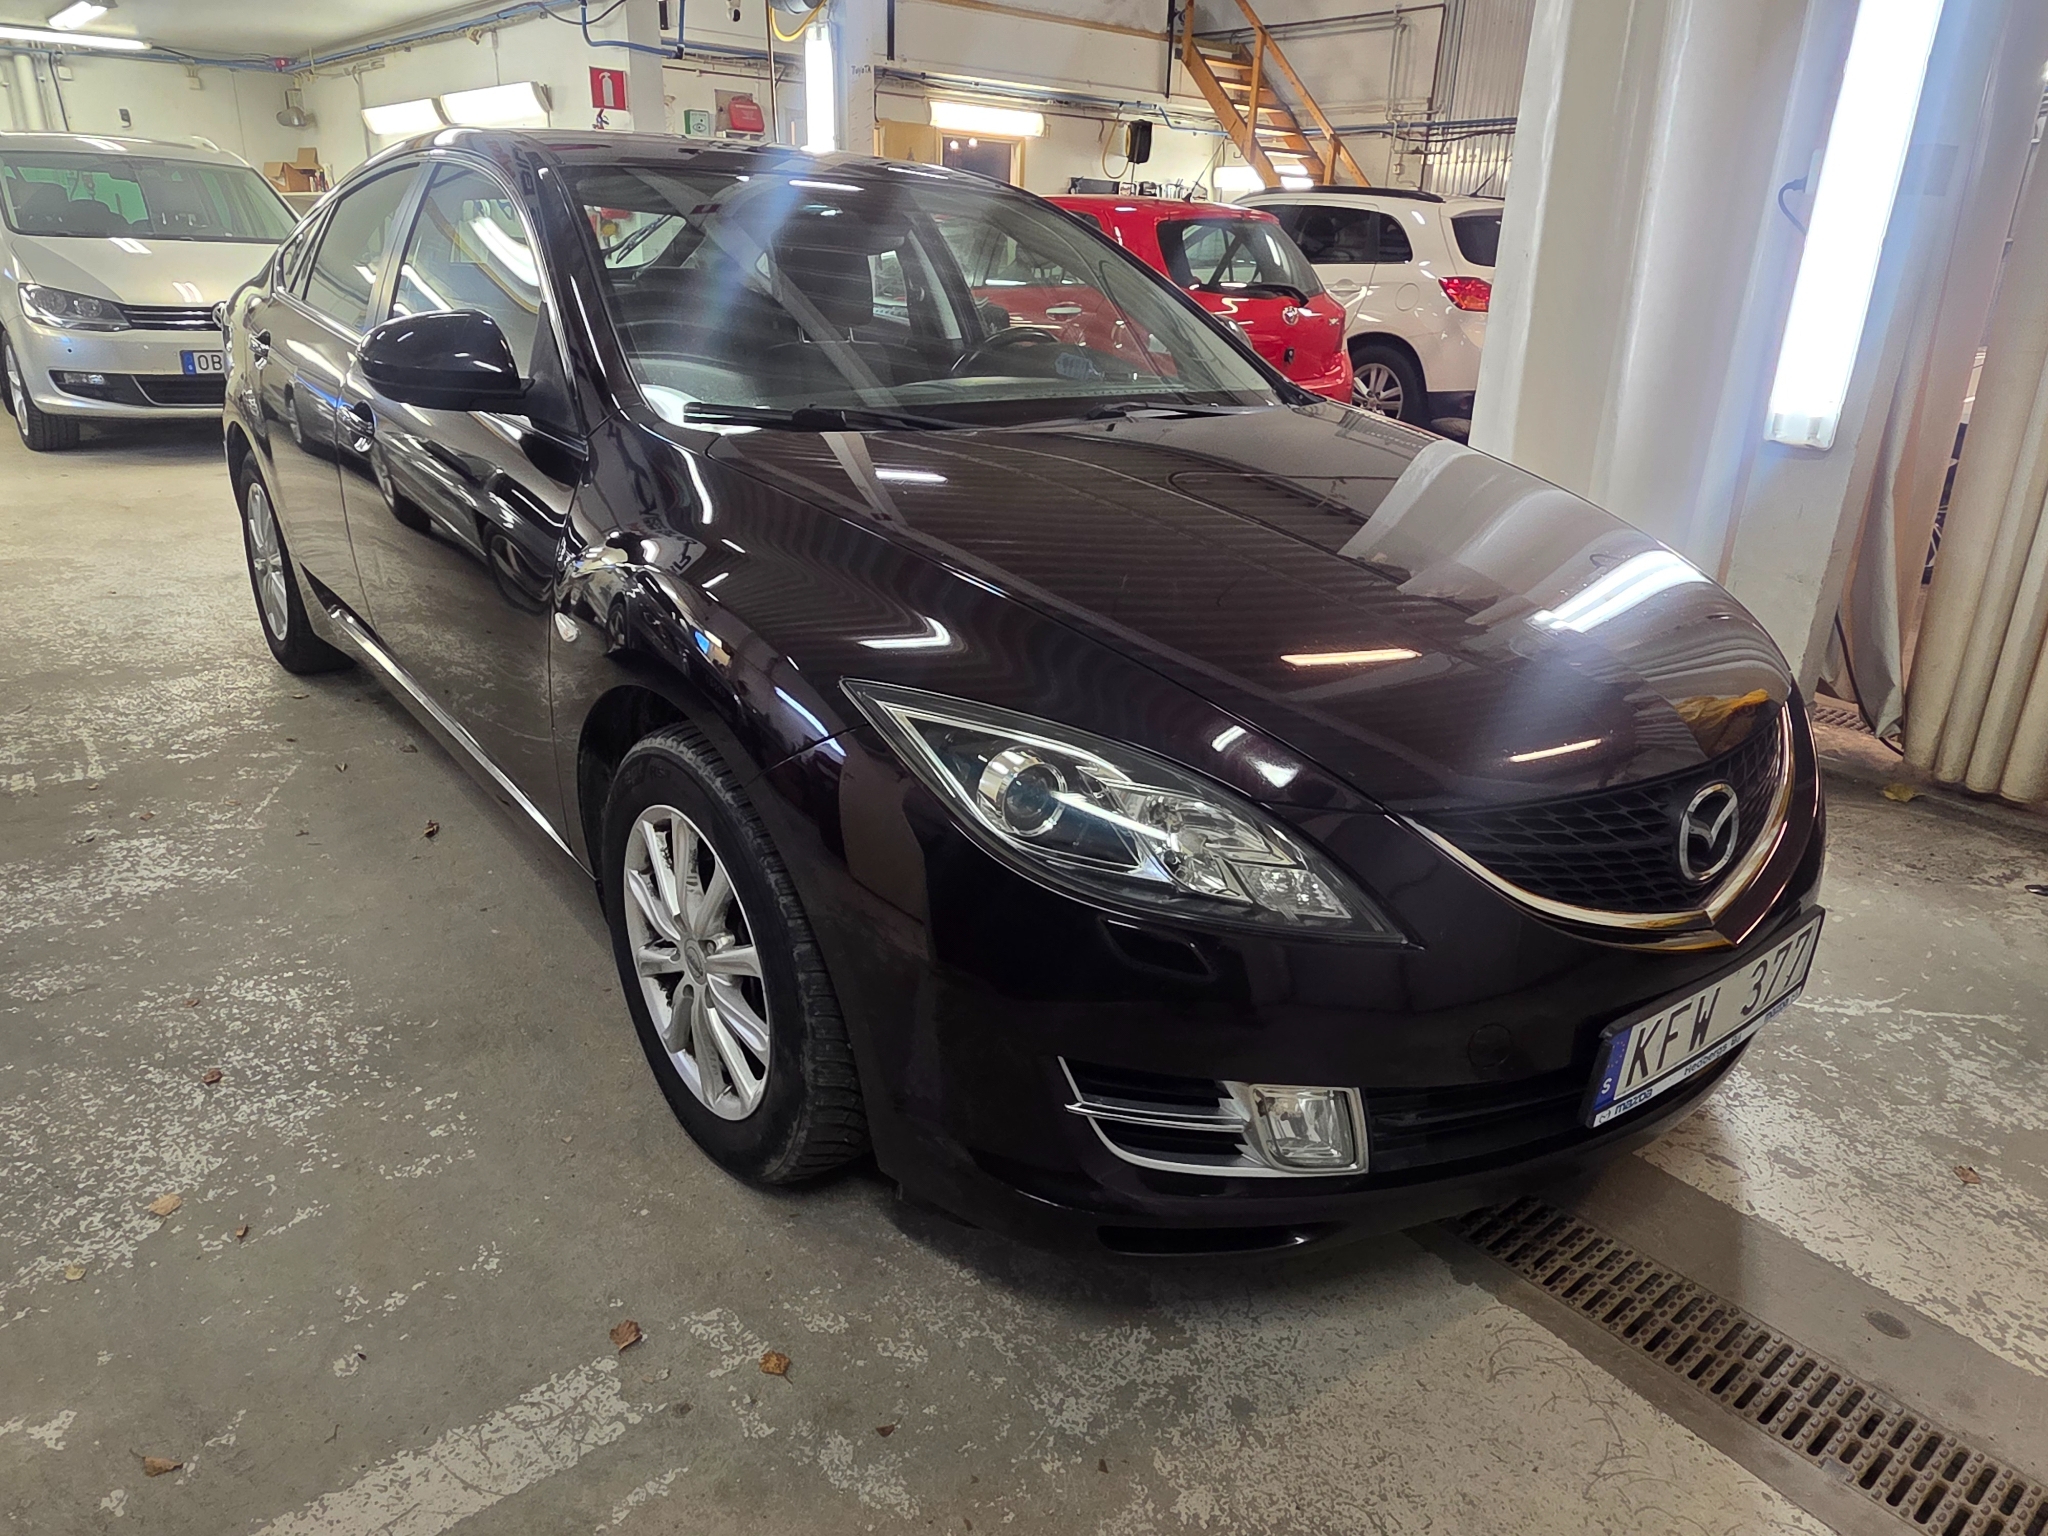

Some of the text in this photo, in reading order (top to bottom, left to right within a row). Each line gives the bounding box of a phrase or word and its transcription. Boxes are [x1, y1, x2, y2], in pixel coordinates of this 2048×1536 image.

[1625, 925, 1813, 1088] KFW 377
[1601, 1077, 1612, 1095] S
[1615, 1088, 1653, 1115] mazda
